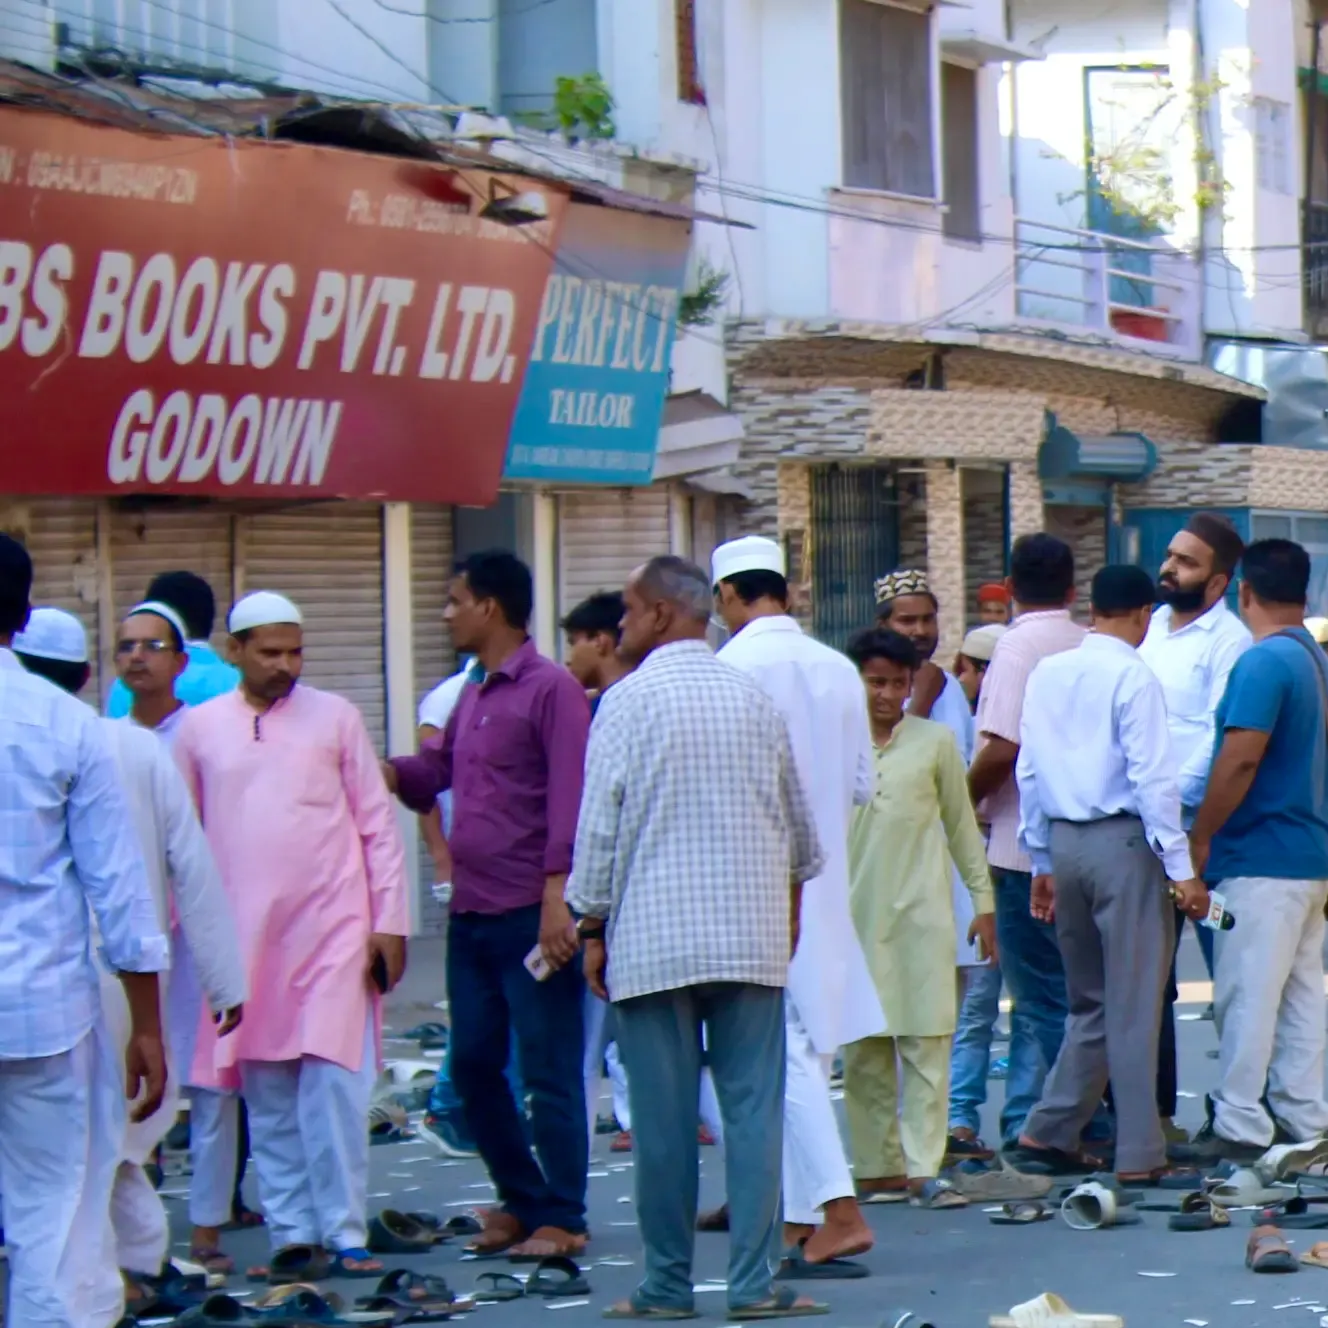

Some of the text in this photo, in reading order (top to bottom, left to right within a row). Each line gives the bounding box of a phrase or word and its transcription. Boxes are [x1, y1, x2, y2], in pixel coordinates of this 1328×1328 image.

[0, 241, 517, 384] BS BOOKS PVT. LTD.
[530, 274, 678, 372] PERFECT
[107, 389, 344, 486] GODOWN
[549, 388, 636, 428] TAILOR
